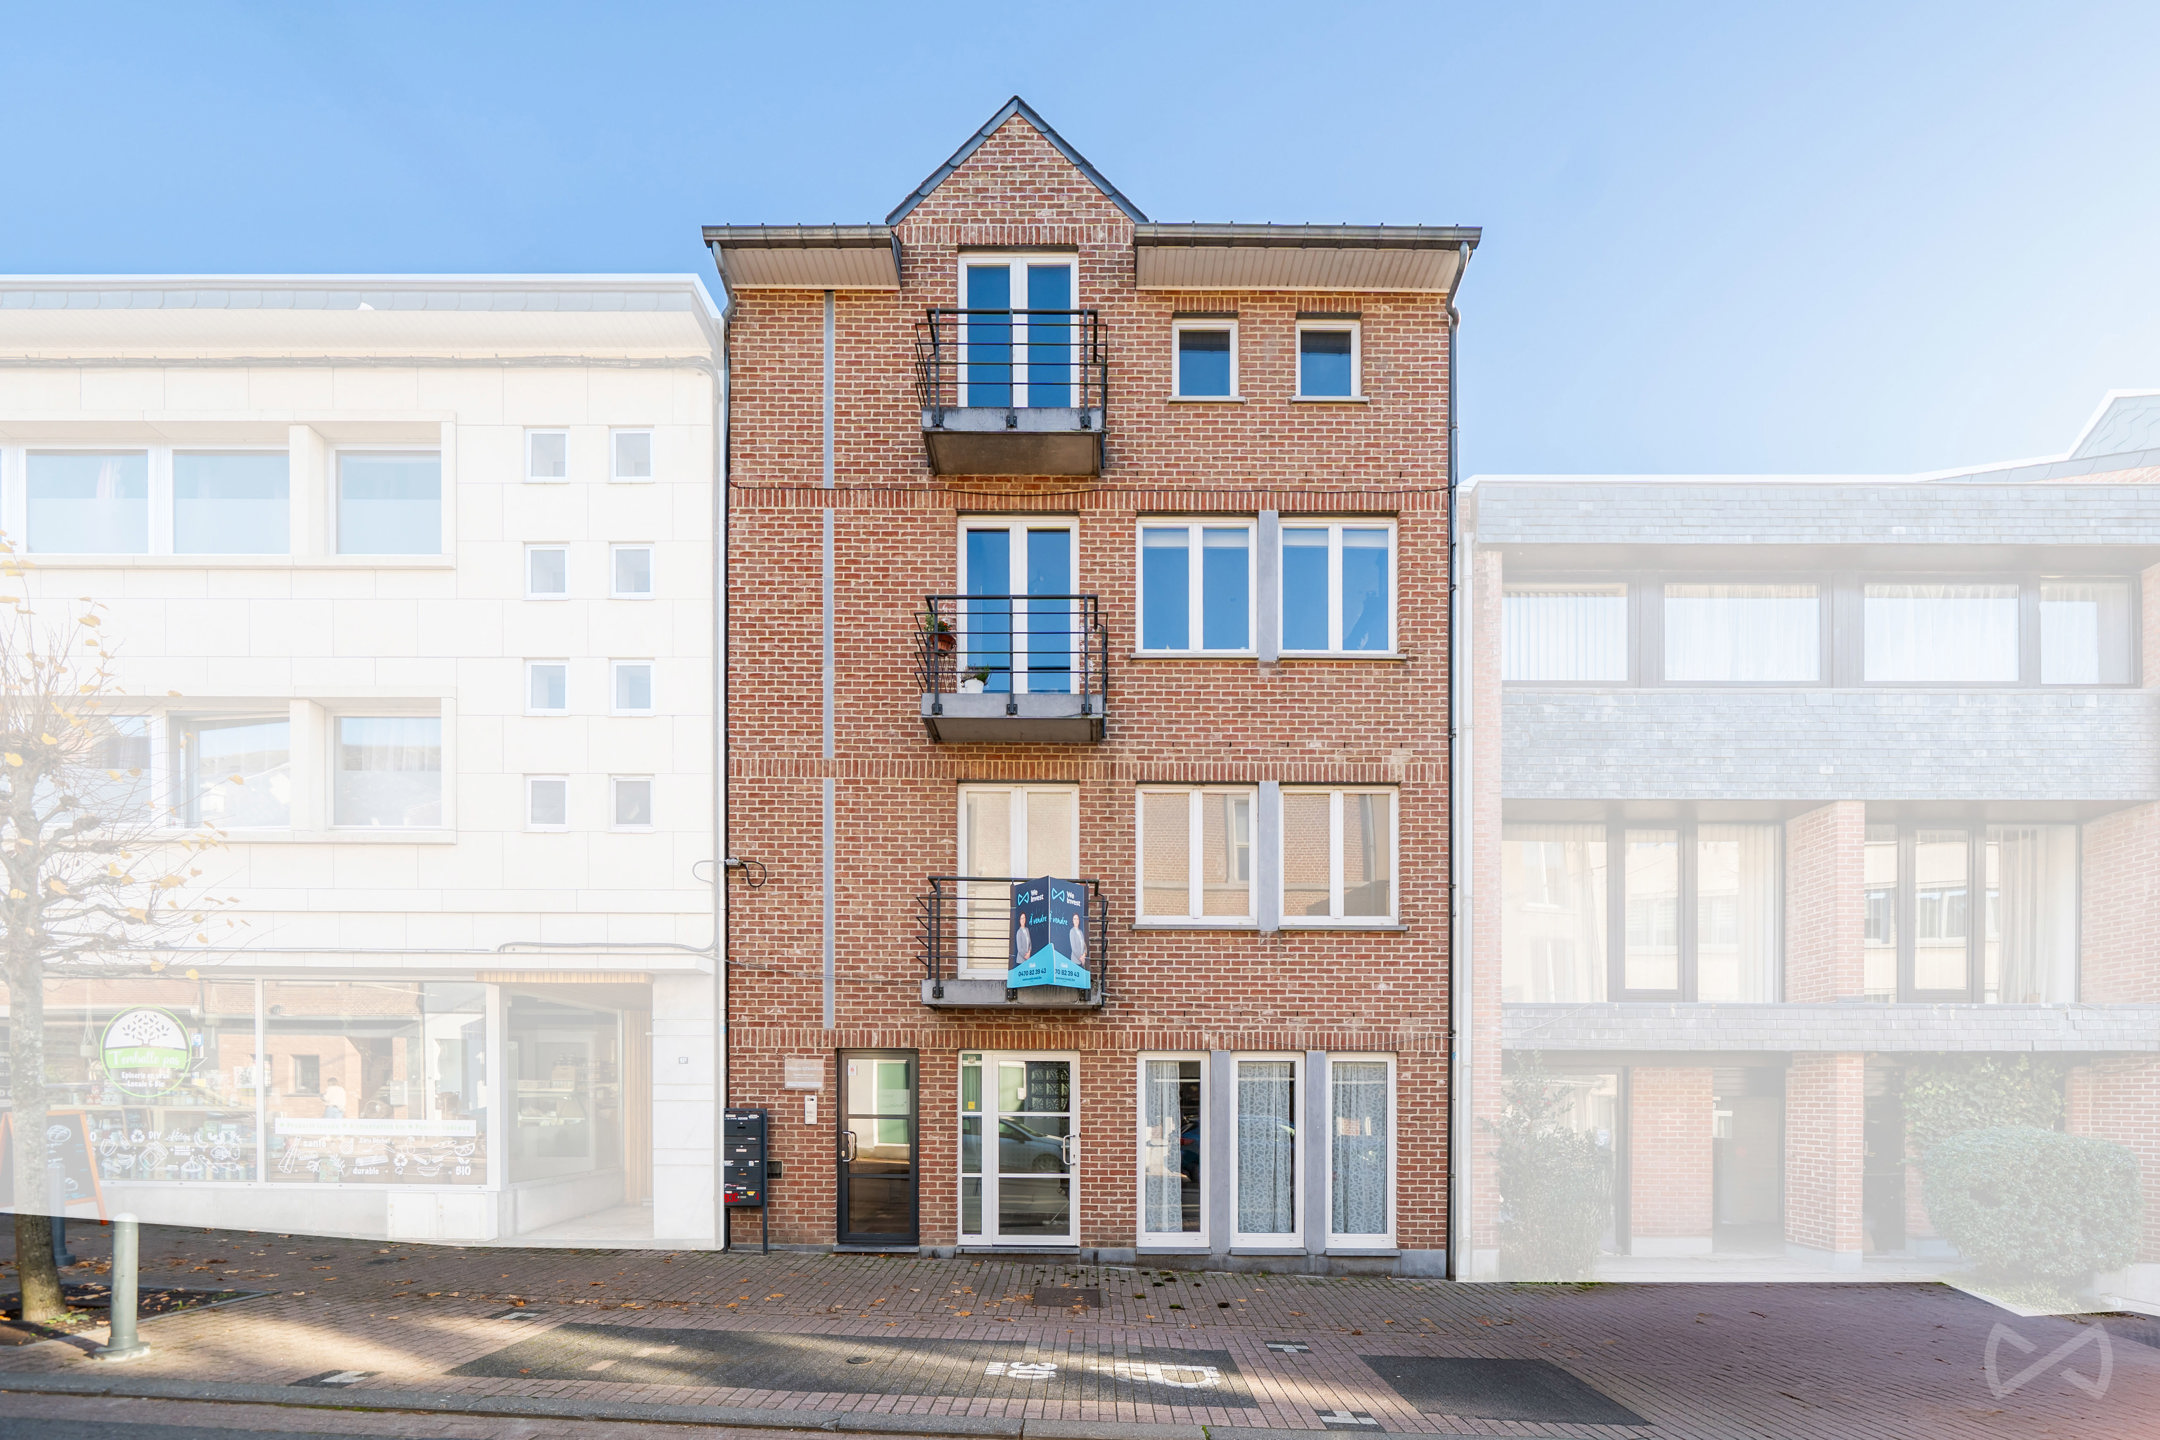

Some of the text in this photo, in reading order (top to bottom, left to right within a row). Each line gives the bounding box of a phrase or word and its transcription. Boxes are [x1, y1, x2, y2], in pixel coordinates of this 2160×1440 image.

[148, 1130, 162, 1140] DIY
[352, 1166, 379, 1175] durable
[455, 1165, 471, 1176] BIO
[1007, 1361, 1058, 1379] 30
